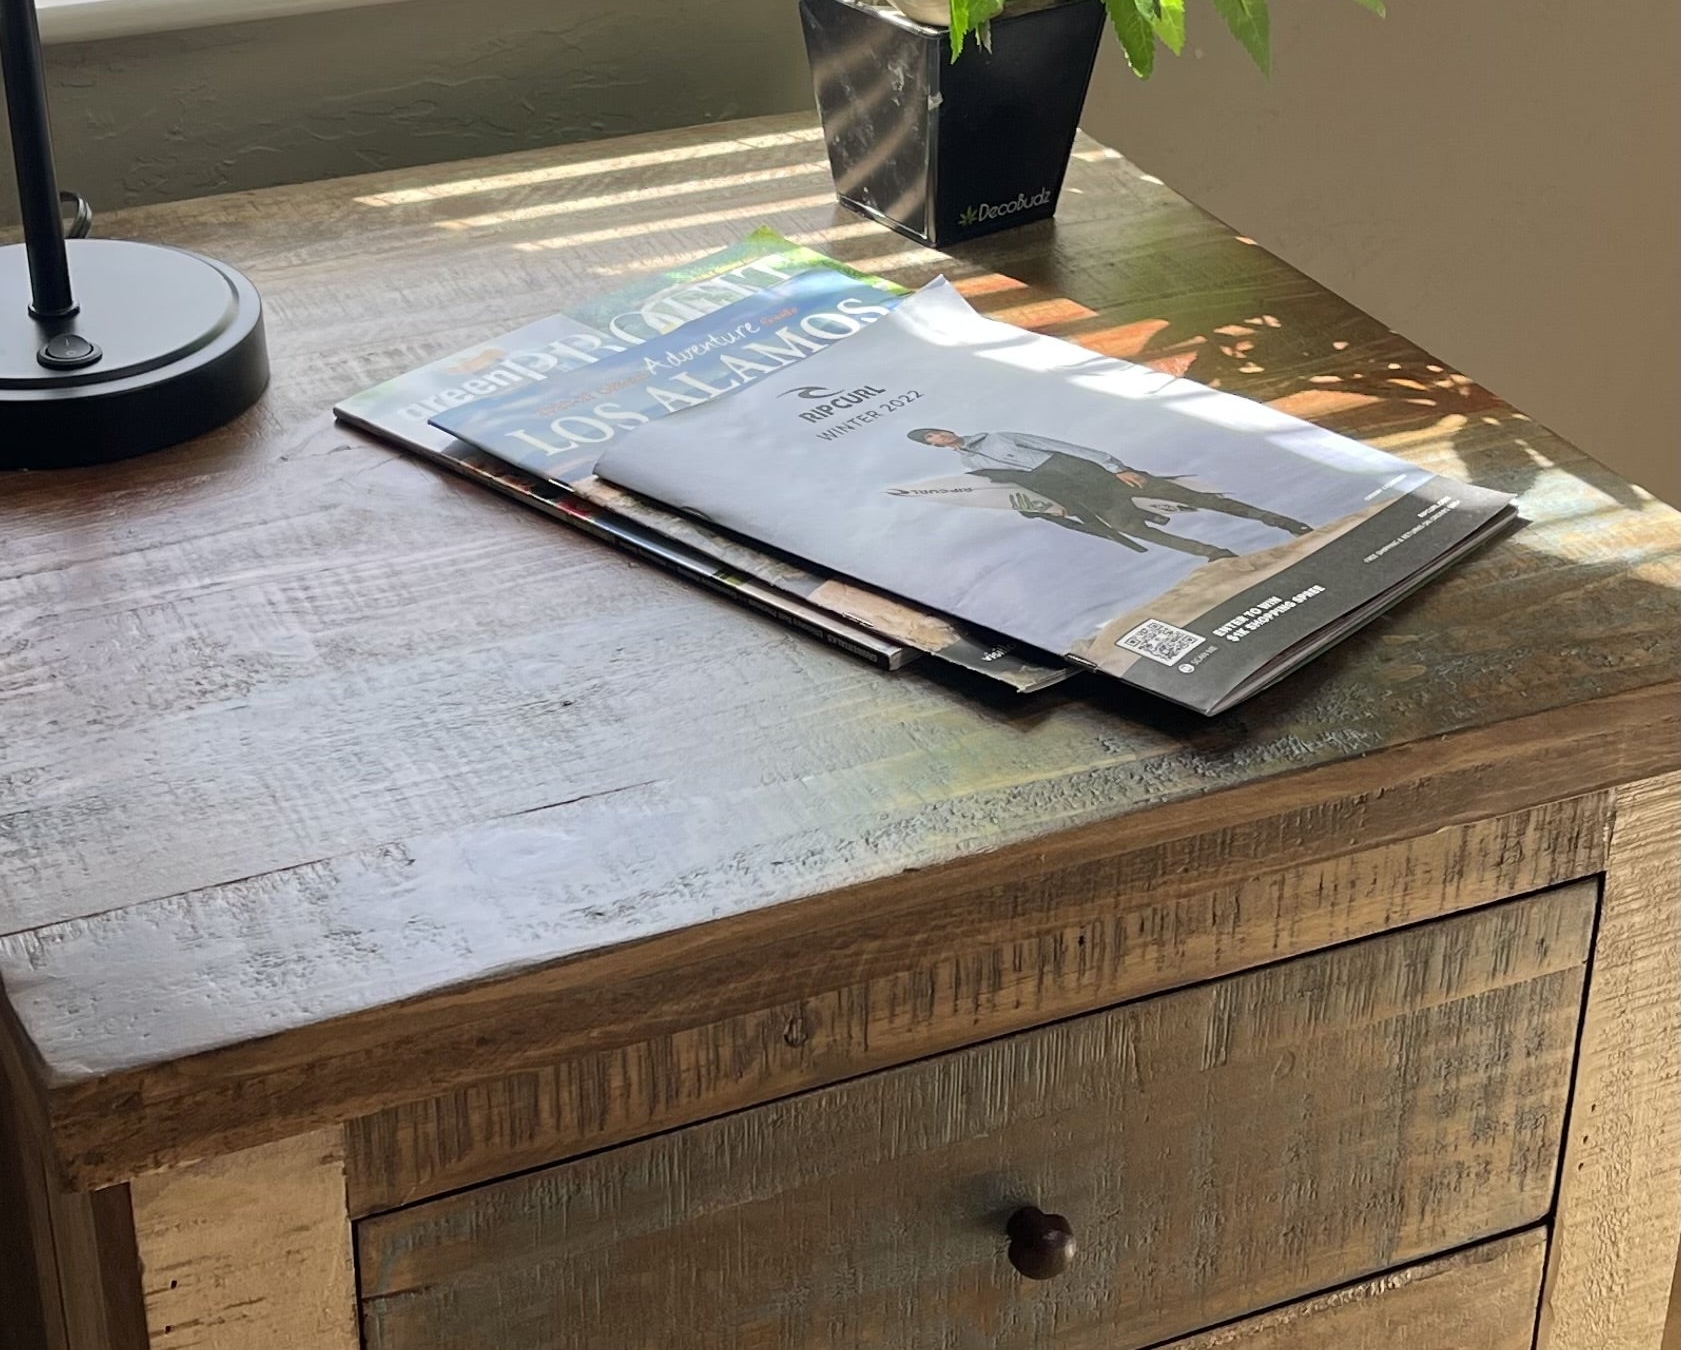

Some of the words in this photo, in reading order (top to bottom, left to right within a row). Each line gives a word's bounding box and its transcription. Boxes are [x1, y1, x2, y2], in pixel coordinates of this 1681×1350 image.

[506, 400, 651, 457] LOS
[646, 296, 892, 417] ALAMOS
[644, 319, 762, 377] Adventure
[816, 410, 883, 441] WINTER
[879, 390, 924, 413] 2022
[1212, 615, 1250, 637] ENTER
[1243, 607, 1262, 618] TO
[1256, 595, 1283, 610] WIN
[1226, 627, 1251, 642] $1K
[1244, 600, 1297, 630] SHOPPING
[1291, 584, 1326, 604] SPREE
